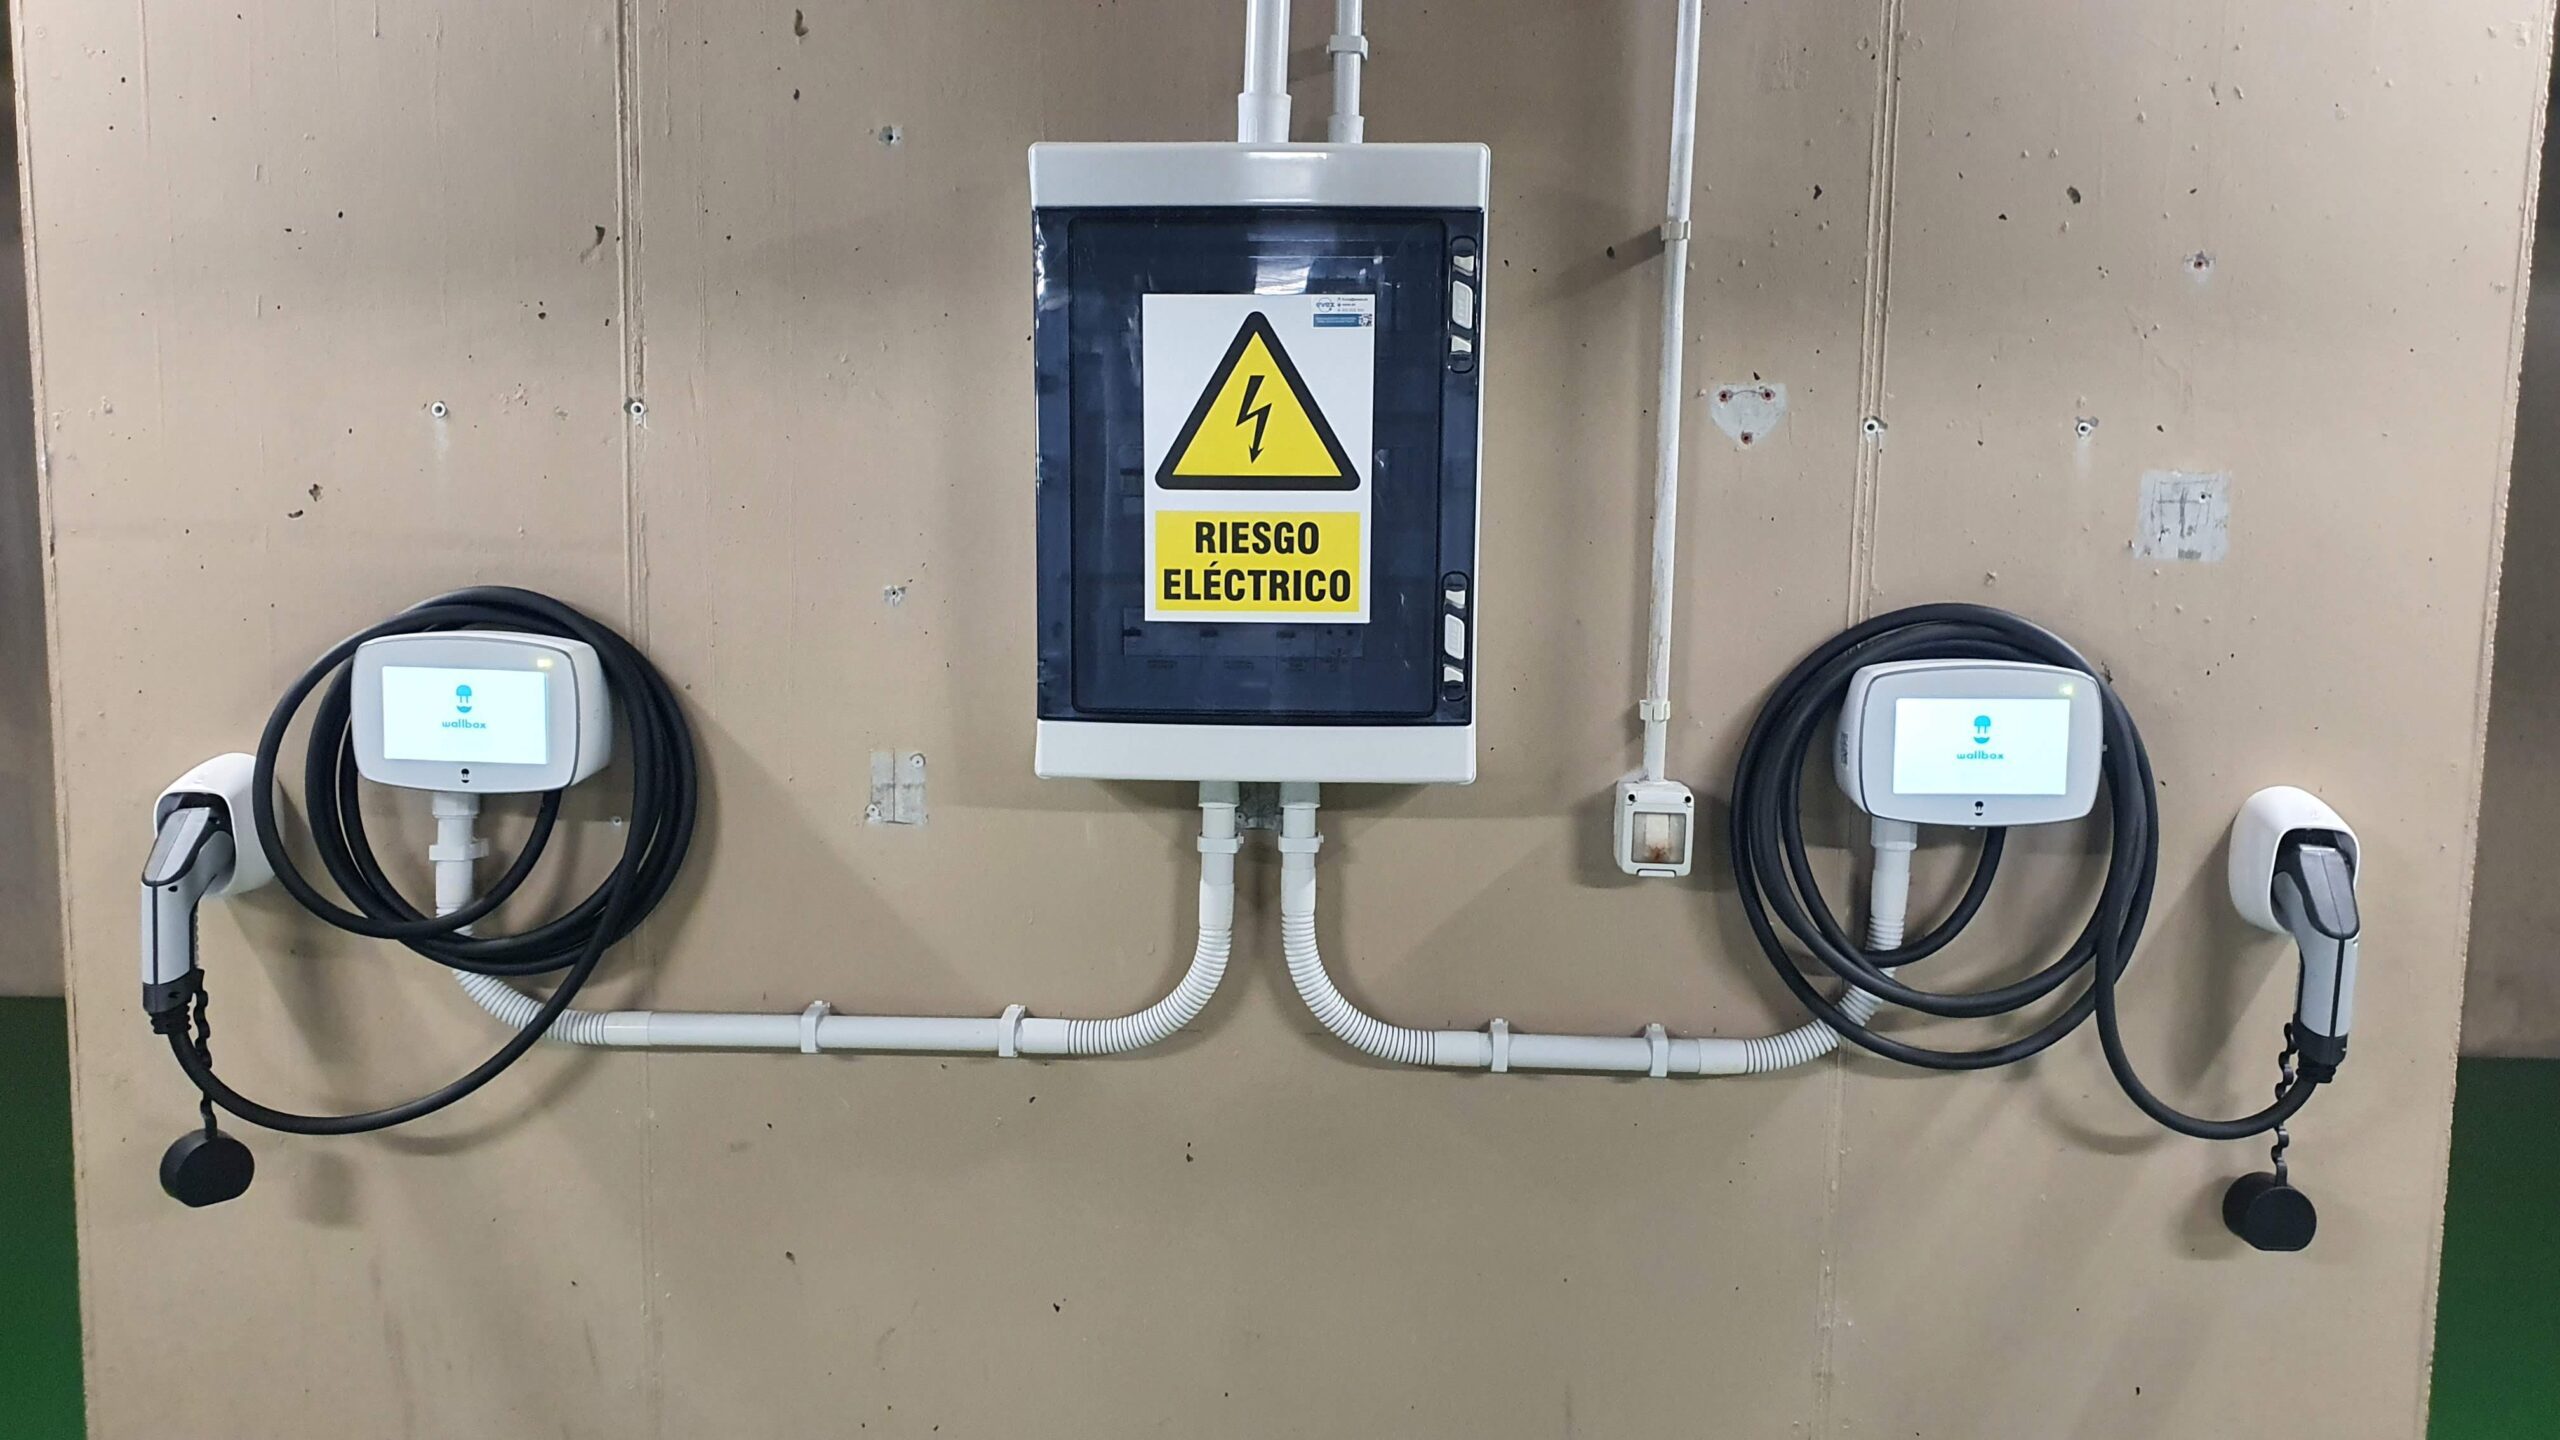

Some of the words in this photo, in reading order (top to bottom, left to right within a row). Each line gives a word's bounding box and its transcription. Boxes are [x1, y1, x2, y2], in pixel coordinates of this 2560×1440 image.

[1195, 521, 1319, 554] RIESGO
[1163, 561, 1351, 602] ELÉCTRICO
[442, 718, 487, 729] wallbox
[1956, 749, 2004, 760] wallbox
